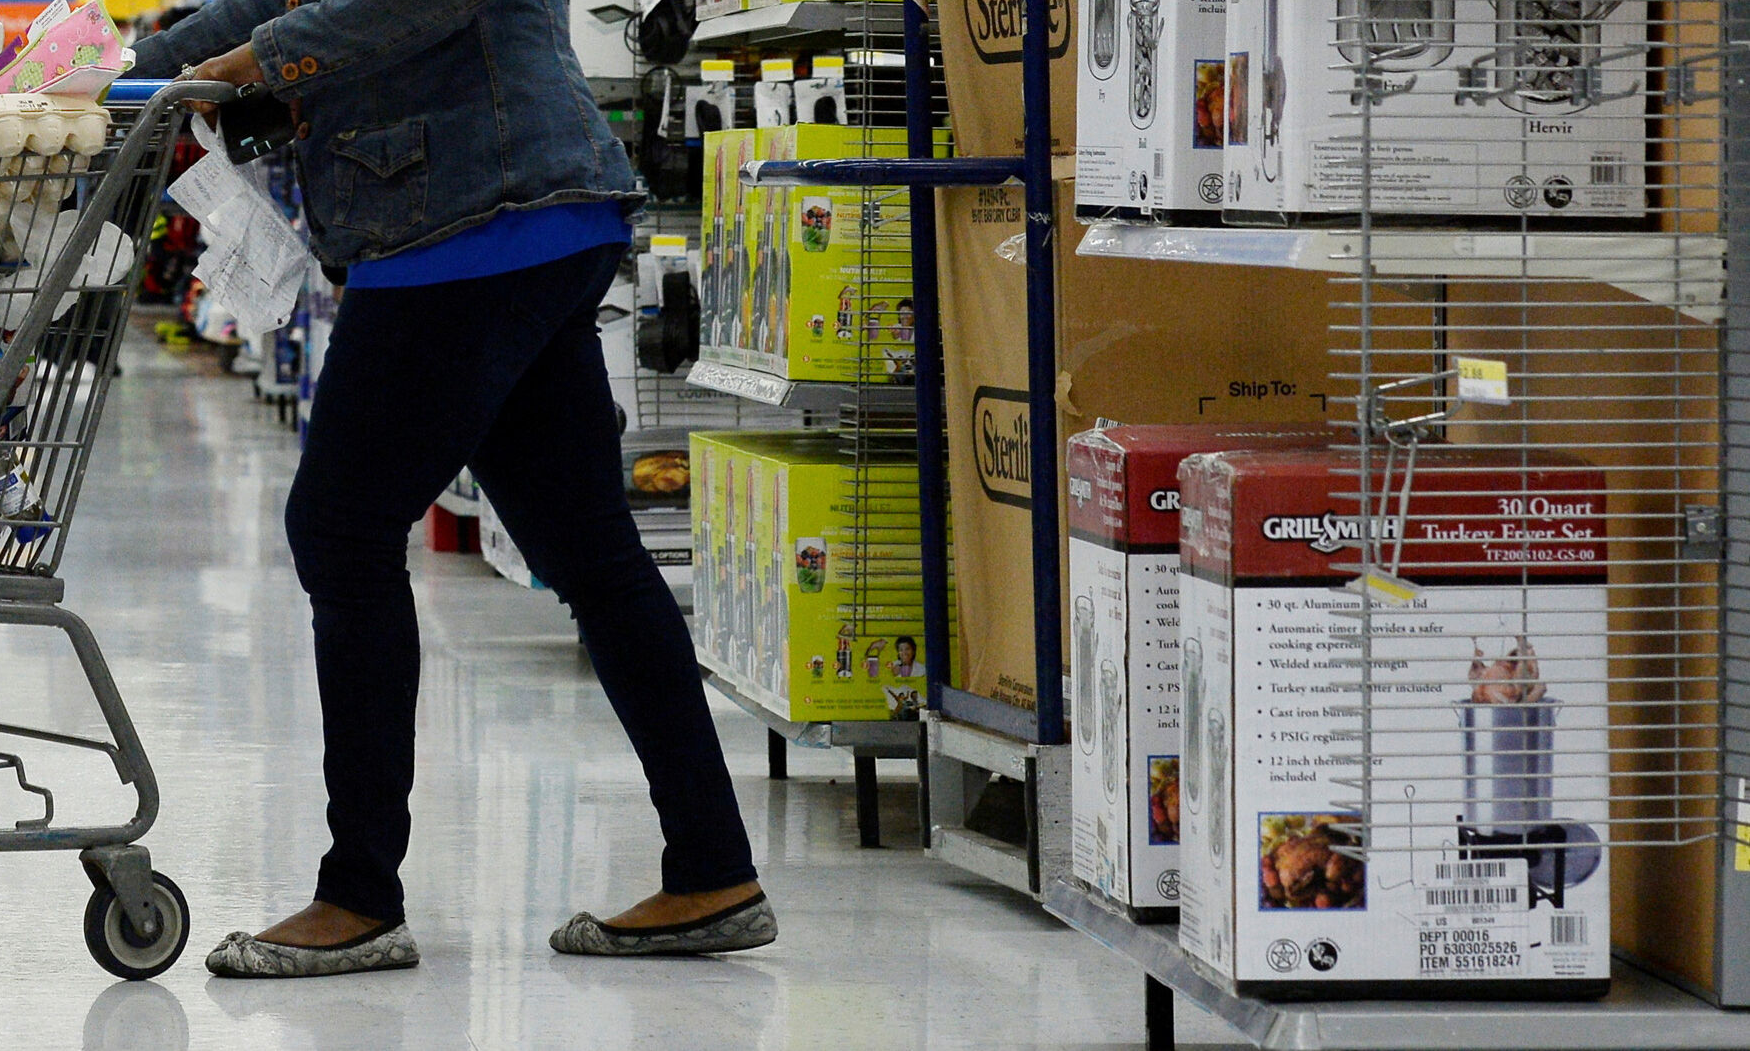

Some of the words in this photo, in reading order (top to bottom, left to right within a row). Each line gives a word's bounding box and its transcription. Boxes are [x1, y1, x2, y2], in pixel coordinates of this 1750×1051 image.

[1528, 120, 1573, 136] Hervir
[1228, 380, 1265, 398] Ship
[1267, 381, 1297, 397] To:
[982, 408, 1030, 484] Sterili
[1498, 497, 1519, 516] 30
[1529, 497, 1593, 522] Quart
[1421, 524, 1492, 549] Turkey
[1561, 523, 1593, 541] Set
[1154, 564, 1167, 574] 30
[1267, 599, 1281, 609] 30
[1284, 600, 1298, 613] qt.
[1301, 599, 1360, 609] Aluminum
[1412, 599, 1428, 609] lid
[1268, 624, 1324, 634] Automatic
[1328, 624, 1358, 634] timer
[1419, 624, 1444, 634] safer
[1268, 640, 1313, 652] cooking
[1157, 661, 1179, 670] Cast
[1269, 659, 1310, 669] Welded
[1269, 683, 1306, 695] Turkey
[1395, 684, 1443, 693] included
[1269, 708, 1293, 717] Cast
[1297, 708, 1319, 717] iron
[1270, 731, 1276, 741] 5
[1280, 731, 1309, 742] PSIG
[1270, 756, 1283, 766] 12
[1286, 756, 1310, 766] inch
[1269, 771, 1317, 782] included
[1435, 917, 1448, 926] US
[1419, 930, 1448, 943] DEPT
[1452, 929, 1490, 942] 00016
[1419, 944, 1437, 956] PO
[1419, 956, 1449, 969] ITEM
[1455, 954, 1522, 968] 551618247
